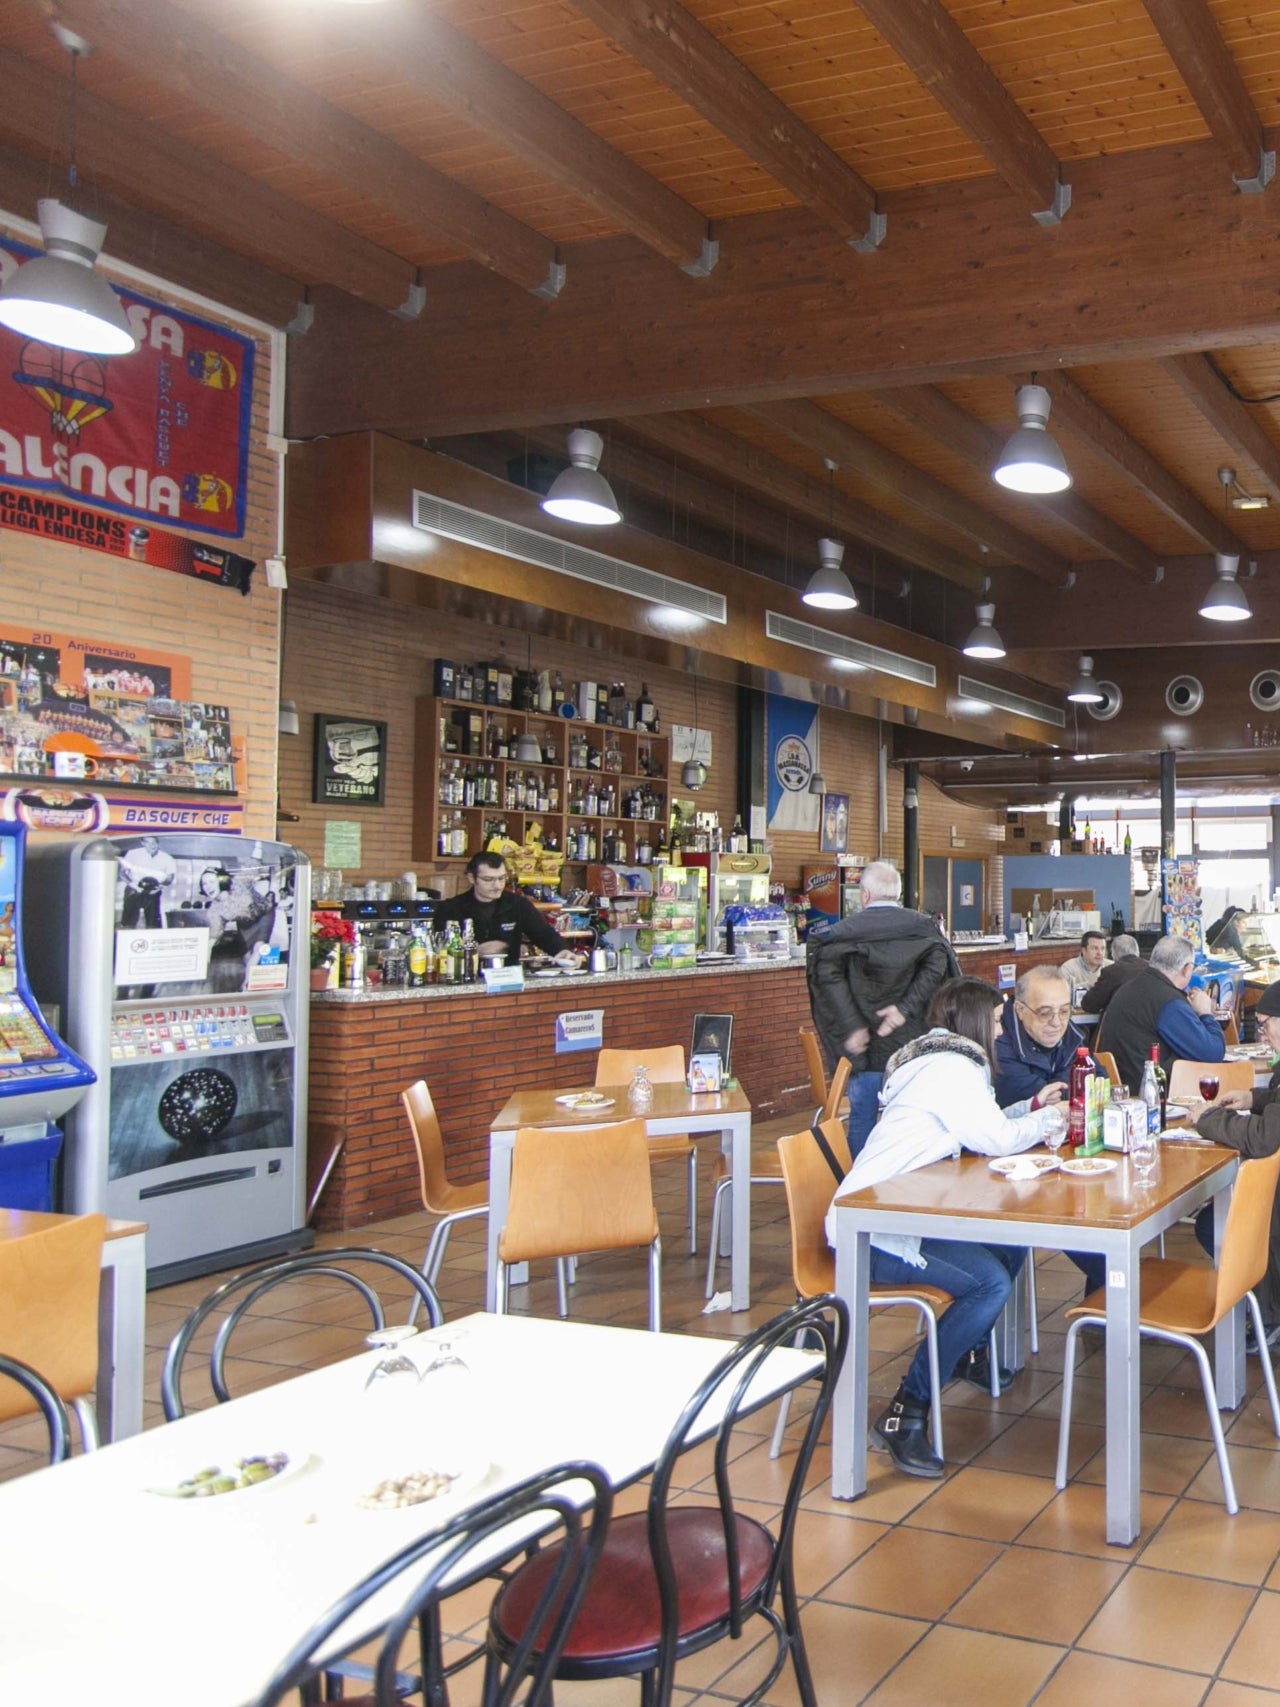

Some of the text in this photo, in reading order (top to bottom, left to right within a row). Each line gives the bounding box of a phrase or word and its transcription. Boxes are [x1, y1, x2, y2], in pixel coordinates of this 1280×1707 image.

[0, 427, 181, 518] ALENCIA
[0, 491, 126, 539] CAMPIONS
[1, 509, 106, 548] LIGA ENDESA
[32, 633, 136, 660] 20 Aniversario
[326, 782, 376, 795] VETERANO
[126, 809, 229, 825] BASQUET CHE
[806, 871, 837, 891] Sunny
